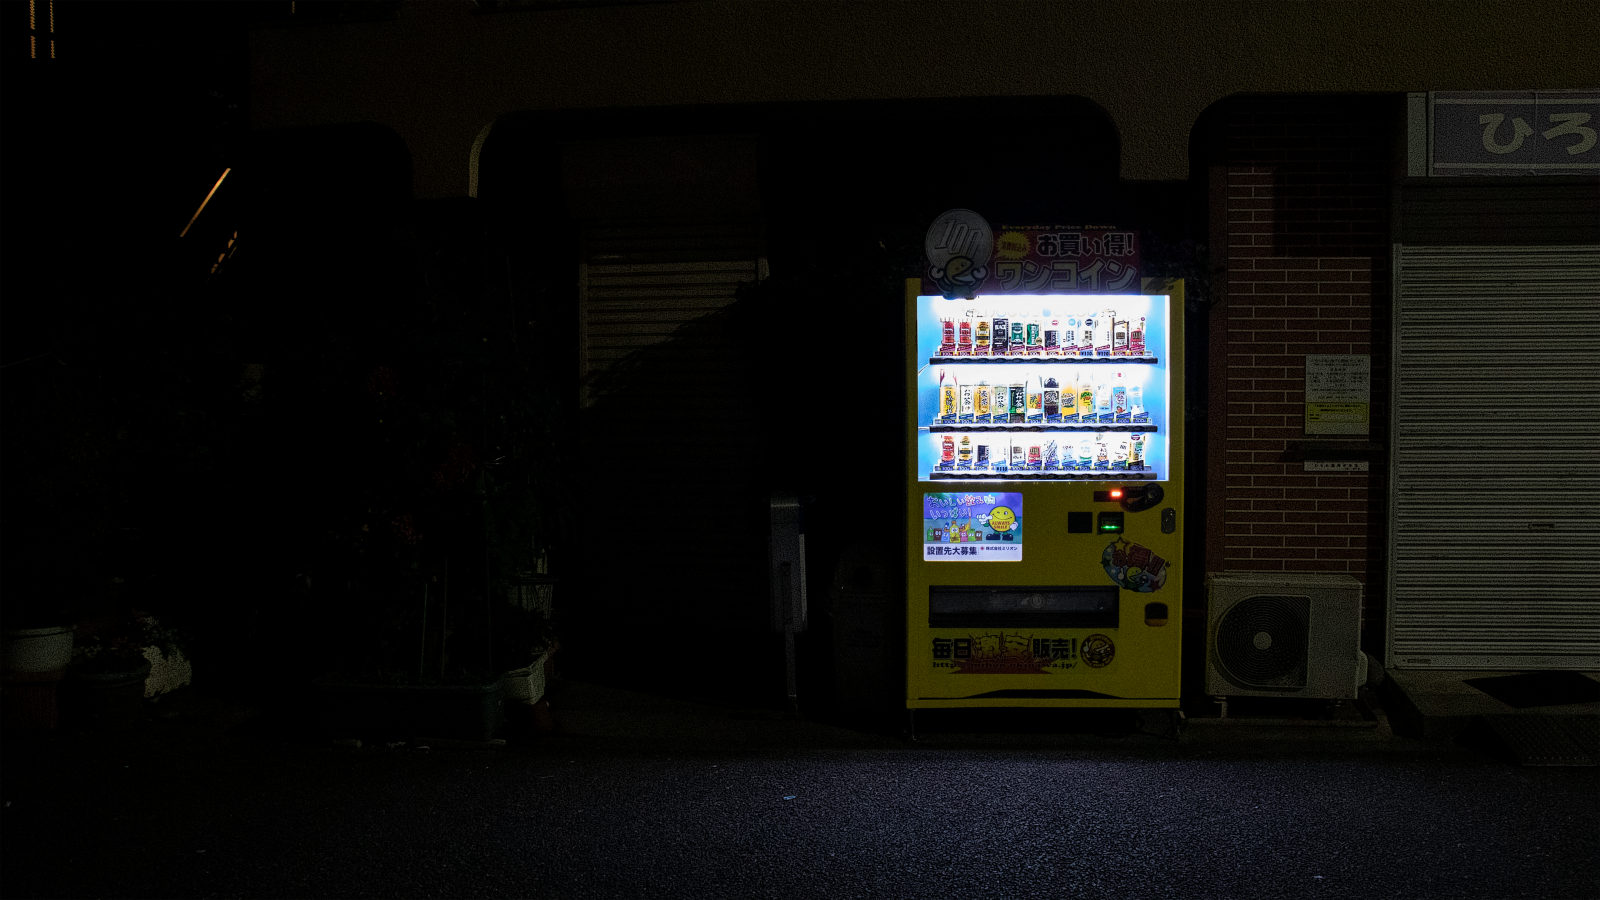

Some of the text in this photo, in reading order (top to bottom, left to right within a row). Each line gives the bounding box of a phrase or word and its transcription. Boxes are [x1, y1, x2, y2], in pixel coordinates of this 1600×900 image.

[1479, 112, 1598, 156] ひろ
[1002, 224, 1051, 232] Everyday
[1036, 232, 1135, 257] お買い得!
[995, 257, 1137, 292] ワンコイン
[926, 546, 978, 556] 設置先大募集
